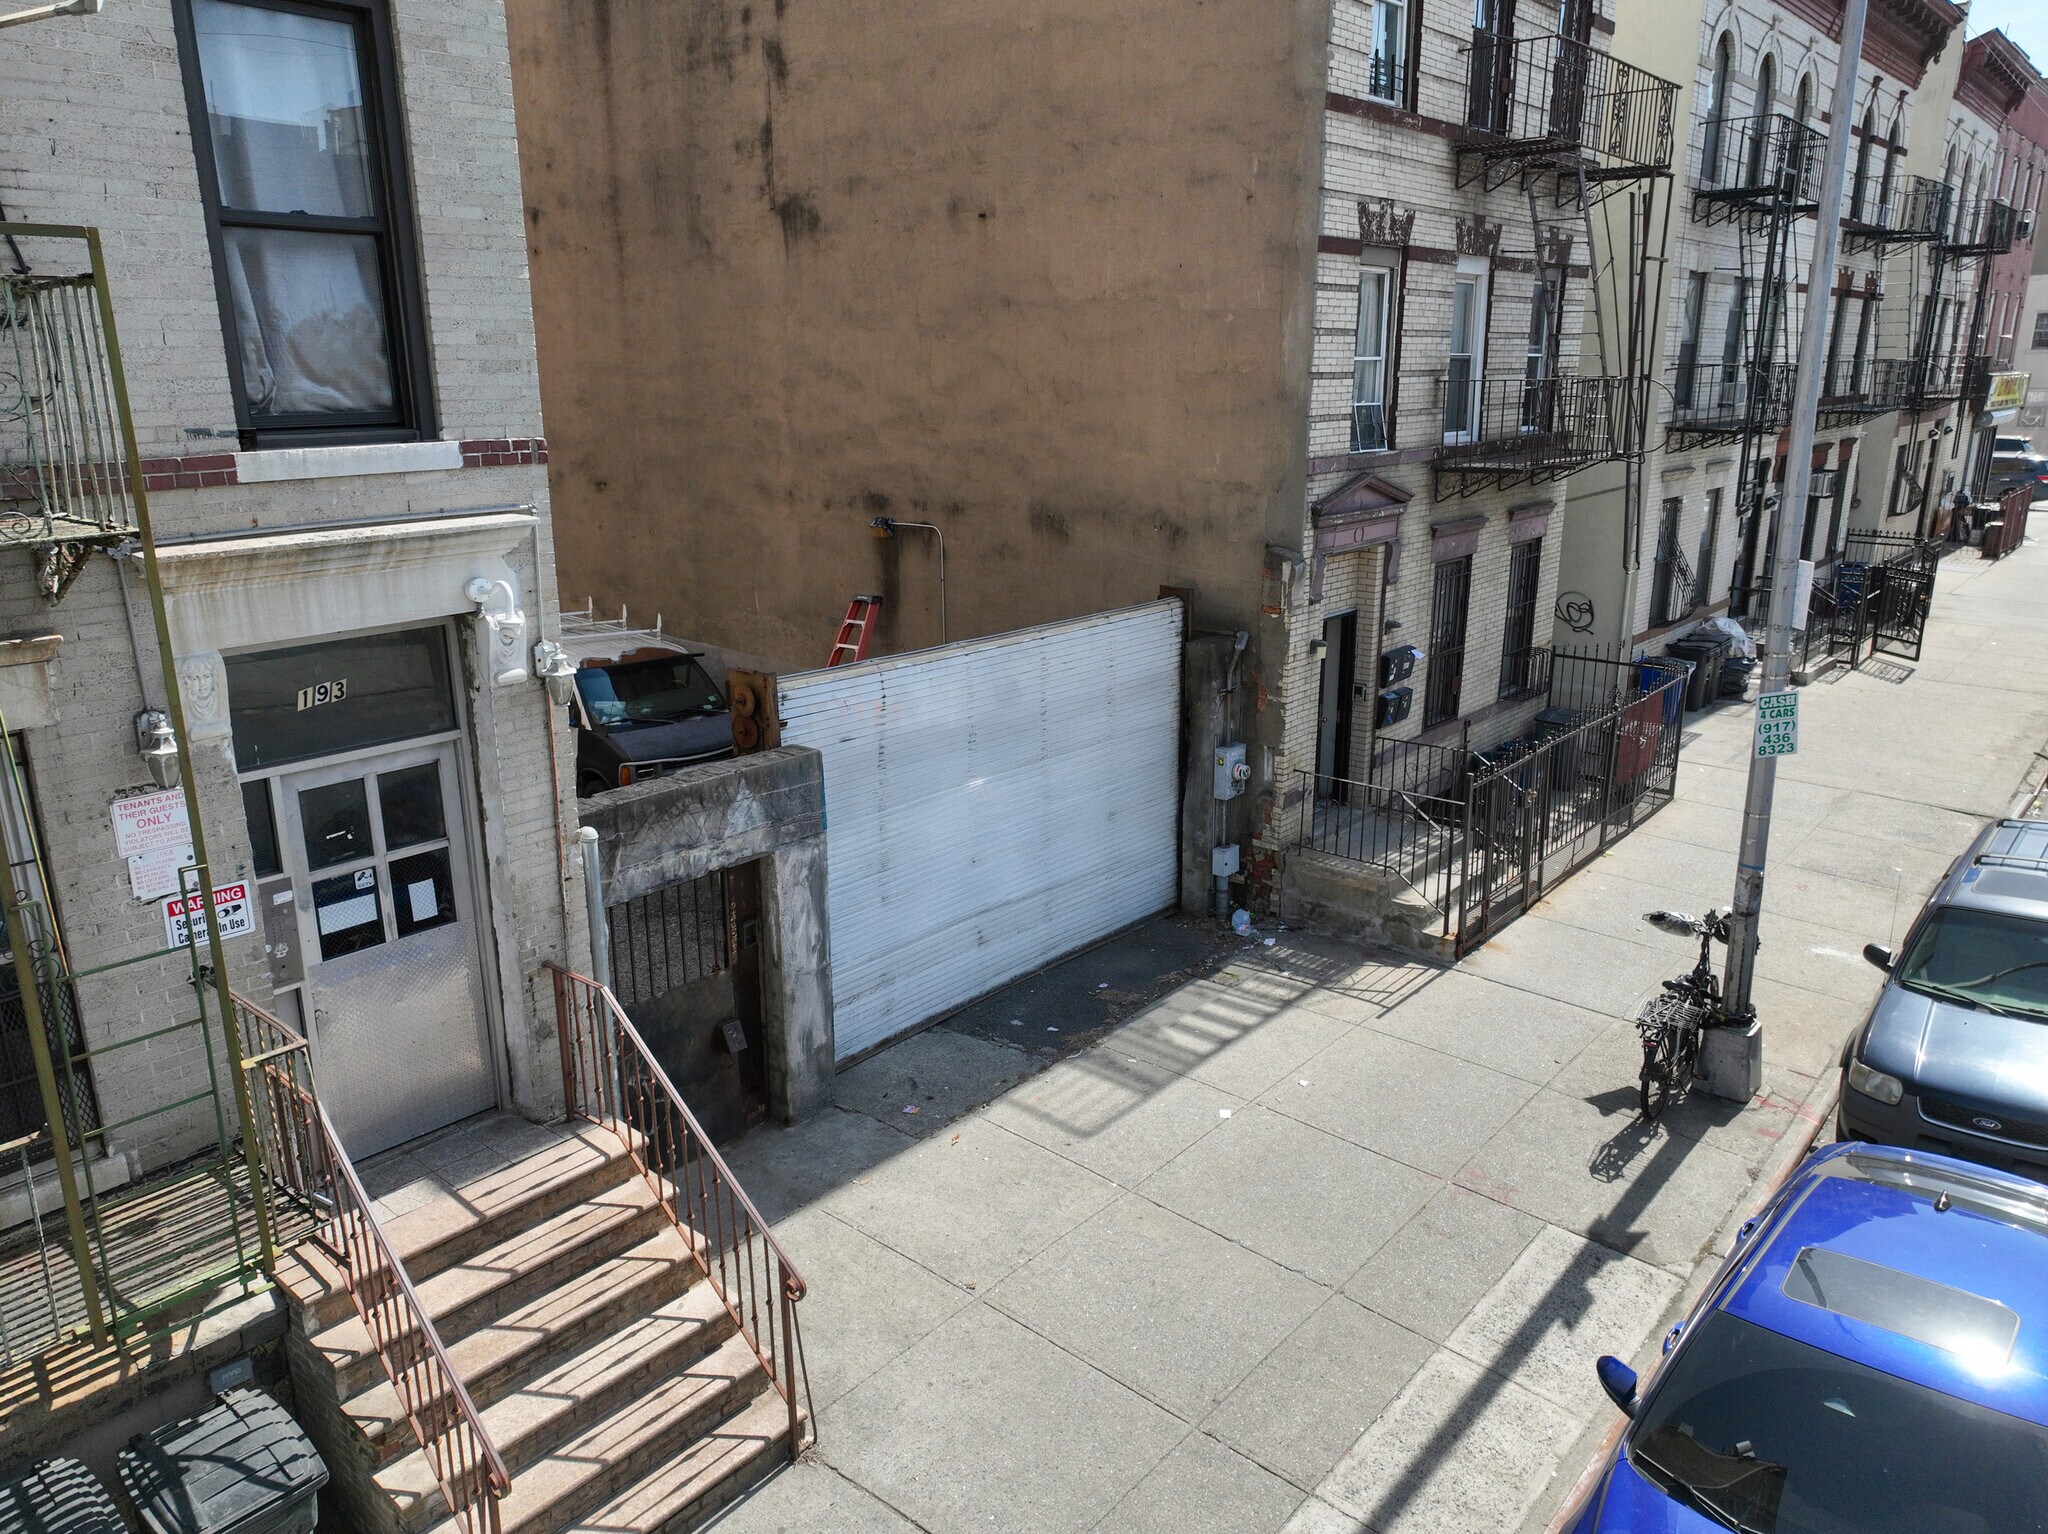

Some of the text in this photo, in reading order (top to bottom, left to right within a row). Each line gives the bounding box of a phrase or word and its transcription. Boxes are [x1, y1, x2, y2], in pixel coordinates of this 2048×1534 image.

[302, 681, 345, 708] 193
[1760, 708, 1795, 719] 4 CARS
[1758, 720, 1796, 735] (917)
[1763, 733, 1791, 744] 436
[1758, 743, 1795, 756] 8323
[117, 792, 184, 811] TENANTS AND
[119, 801, 186, 820] THEIR GUESTS
[136, 813, 172, 828] ONLY
[138, 821, 187, 835] TRESPASSING
[123, 841, 154, 853] SUBJECT
[167, 832, 192, 843] ARREST
[124, 834, 163, 846] VIOLATORS
[164, 829, 179, 837] WILL
[219, 922, 228, 933] In
[229, 918, 245, 930] Use
